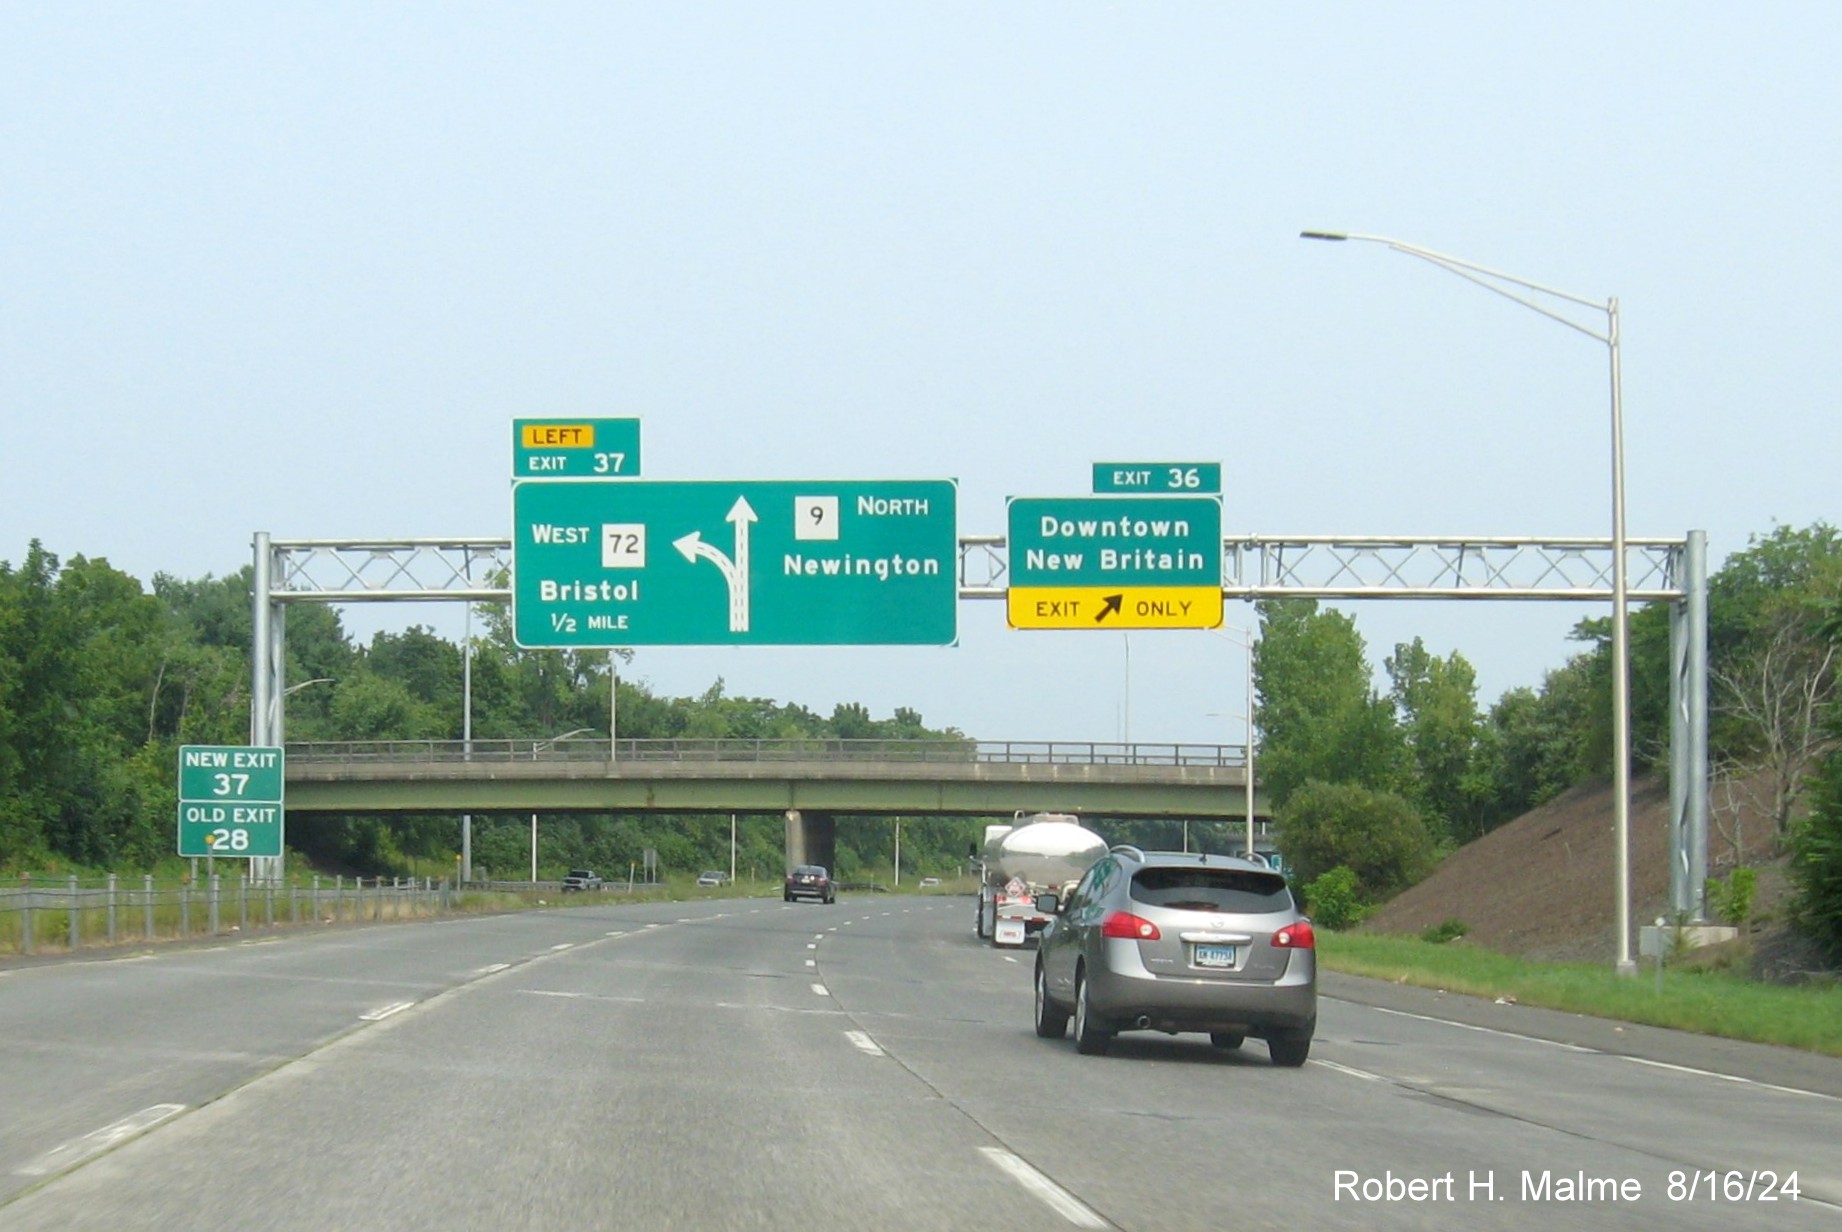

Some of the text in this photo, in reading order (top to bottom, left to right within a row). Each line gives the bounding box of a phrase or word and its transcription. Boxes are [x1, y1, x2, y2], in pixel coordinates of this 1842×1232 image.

[533, 428, 582, 445] LEFT
[528, 453, 625, 473] EXIT 37
[1113, 468, 1201, 489] EXIT 36
[857, 495, 929, 516] NORTH
[810, 507, 824, 526] 9
[1041, 515, 1189, 538] Downtown
[532, 524, 590, 544] WEST
[608, 533, 640, 554] 72
[784, 554, 939, 581] Newington
[1026, 548, 1204, 571] New Britain
[540, 579, 638, 602] Bristol
[1036, 601, 1192, 617] EXIT ONLY
[587, 615, 628, 630] MILE
[186, 752, 277, 768] NEW EXIT
[213, 773, 250, 796] 37
[186, 807, 276, 823] OLD EXIT
[212, 828, 249, 851] 28
